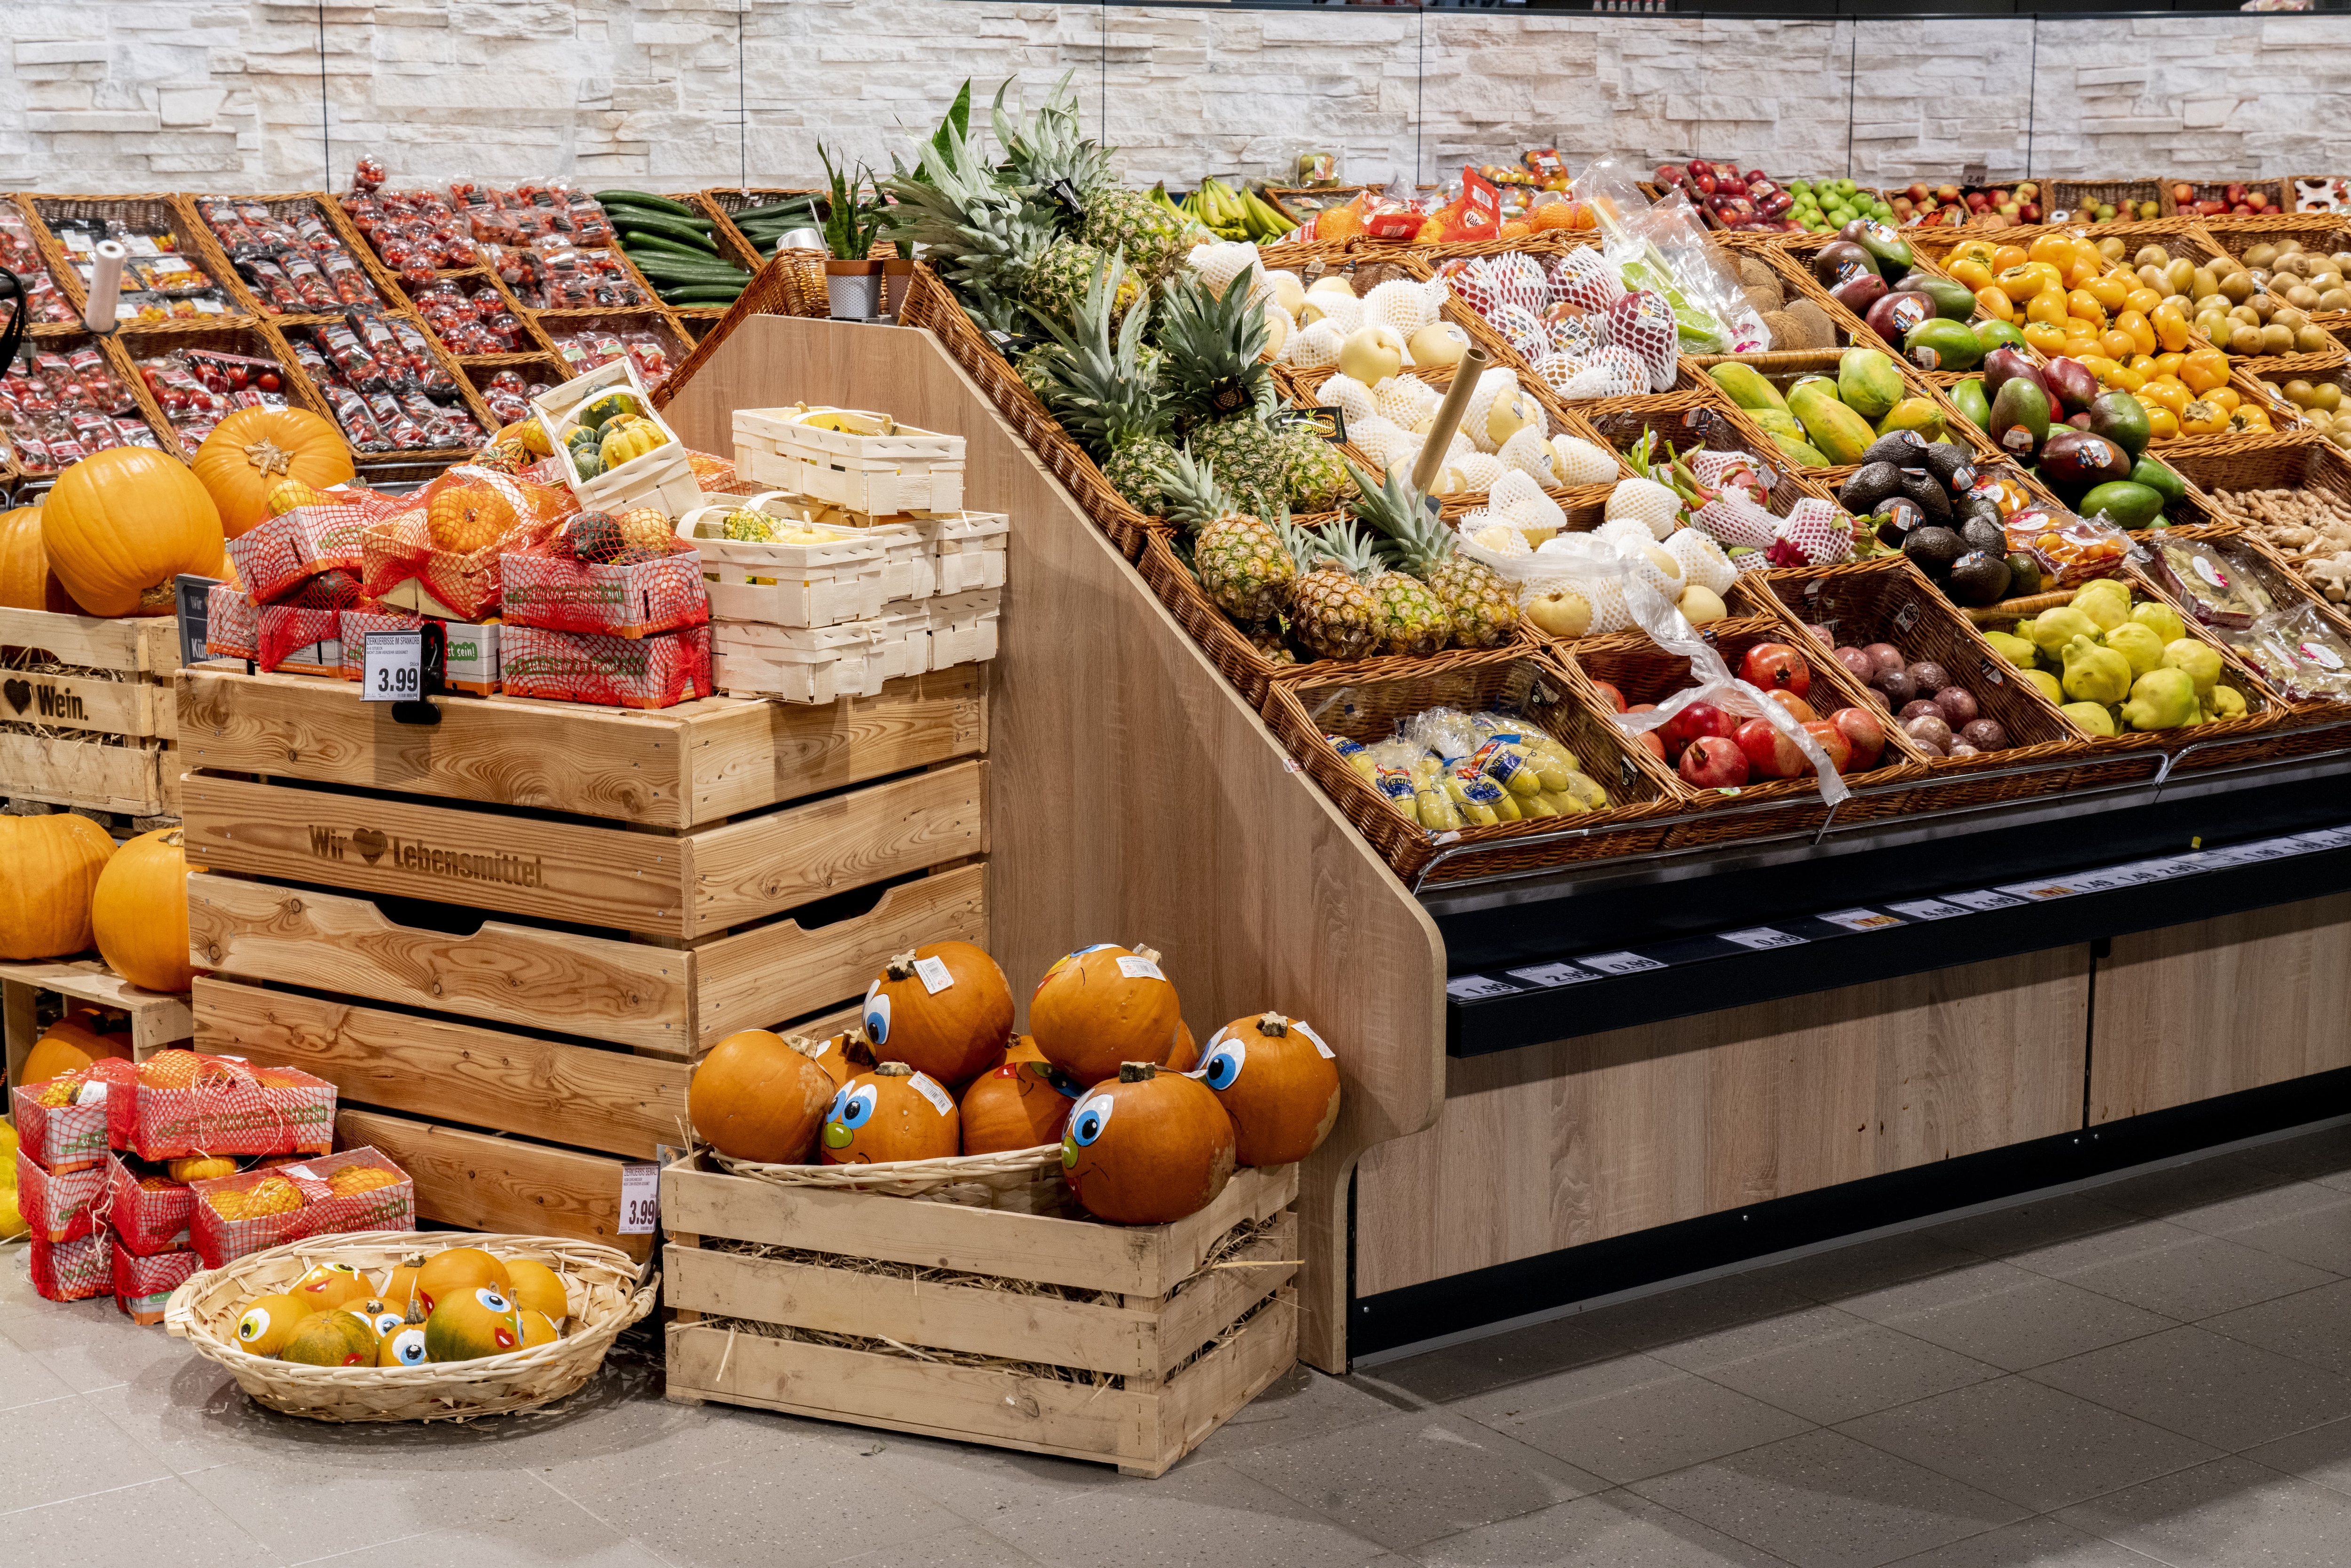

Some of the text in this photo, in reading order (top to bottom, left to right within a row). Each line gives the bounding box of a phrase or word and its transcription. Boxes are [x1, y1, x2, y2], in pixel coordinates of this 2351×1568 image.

[367, 637, 394, 645] ZIERKUERBISSE
[395, 637, 400, 645] IM
[457, 646, 475, 657] sein!
[378, 668, 418, 692] 3.99
[37, 685, 88, 721] Wein.
[308, 824, 550, 889] Wir Lebensmittel.
[2244, 849, 2284, 858] 1.99
[2156, 865, 2199, 875] 2.99
[2117, 872, 2158, 882] 1.49
[2073, 879, 2115, 890] 1.49
[1974, 897, 2018, 907] 3.99
[1921, 907, 1964, 916] 4.99
[1754, 935, 1800, 946] 0.99
[1609, 959, 1658, 970] 0.99
[1545, 970, 1595, 982] 2.99
[1465, 983, 1514, 994] 1.99
[624, 1167, 658, 1176] ZIERKUERBIS BEMALT
[629, 1200, 655, 1225] 3.99
